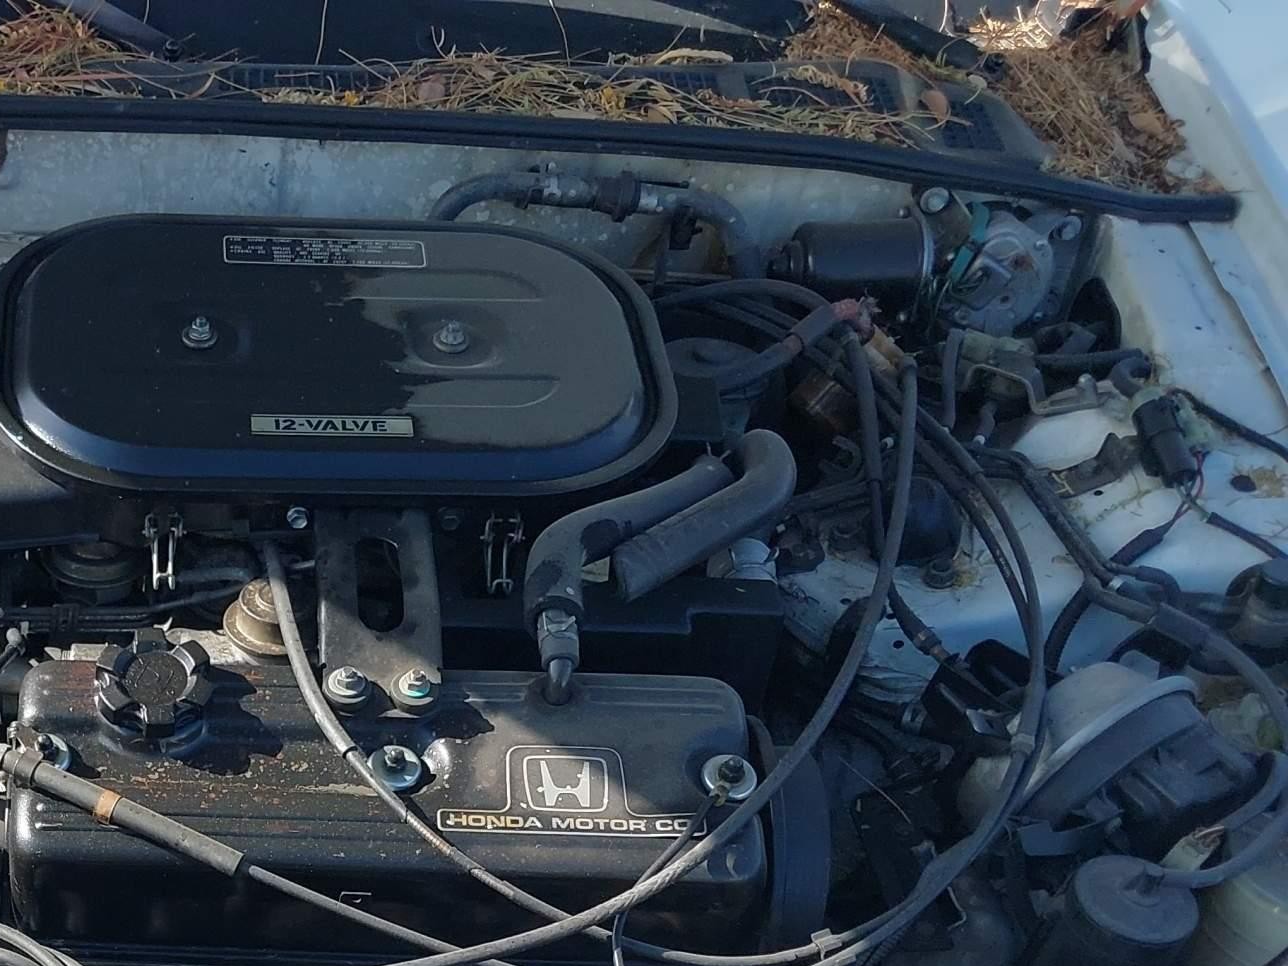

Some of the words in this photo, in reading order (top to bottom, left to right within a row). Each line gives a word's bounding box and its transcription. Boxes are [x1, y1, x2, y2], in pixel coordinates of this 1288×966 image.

[274, 418, 388, 432] 12-VALVE
[448, 814, 544, 829] HONDA
[552, 816, 648, 832] MOTOR
